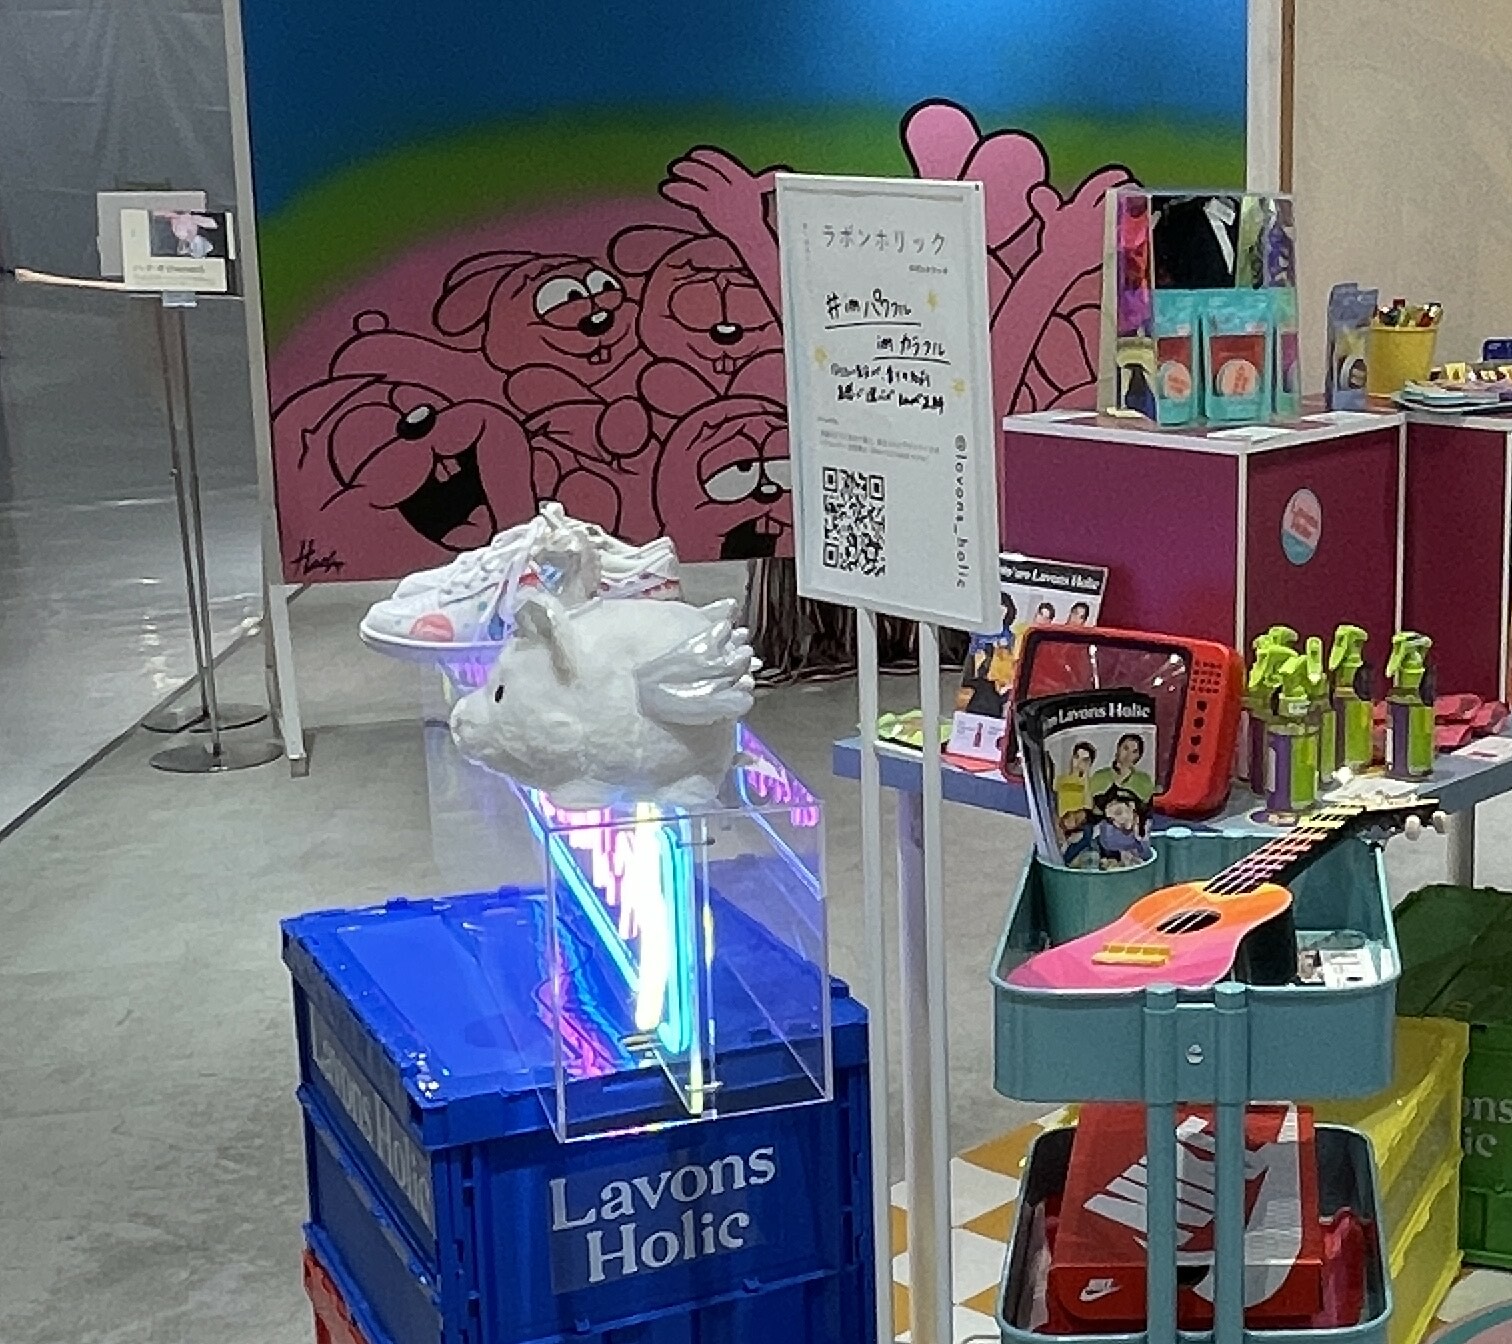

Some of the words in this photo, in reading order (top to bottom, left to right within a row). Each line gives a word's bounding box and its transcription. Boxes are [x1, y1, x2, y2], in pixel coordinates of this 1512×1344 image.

[822, 224, 945, 255] ラボンホリック
[1058, 706, 1107, 724] Lavons
[1108, 702, 1151, 718] Holic
[548, 1146, 776, 1231] Lavons
[586, 1209, 750, 1284] Holic
